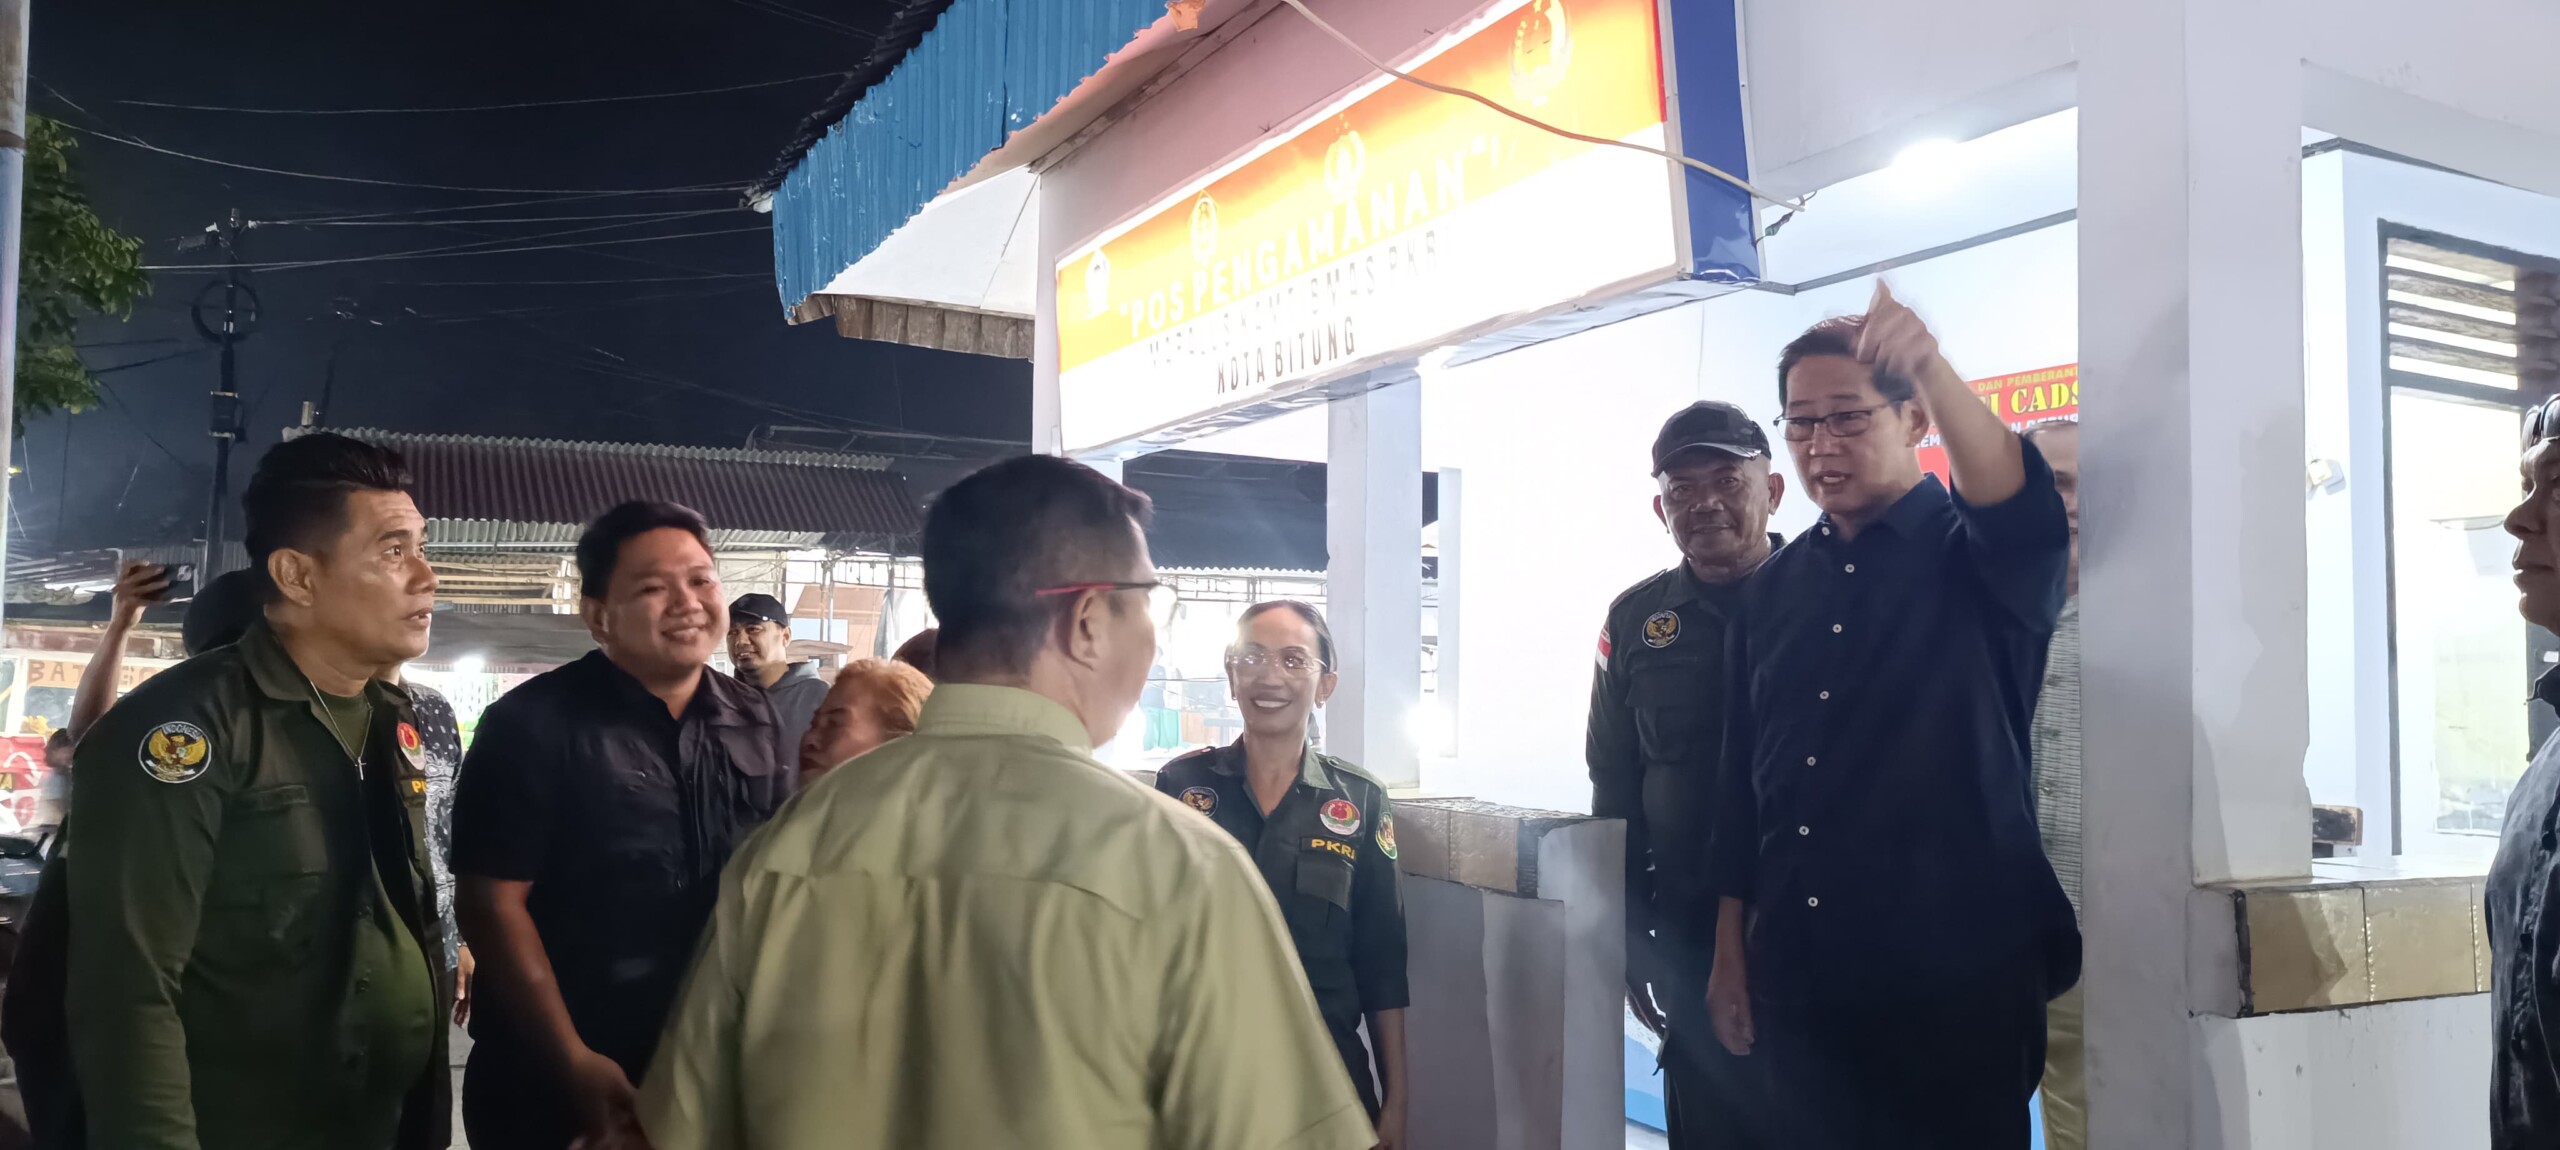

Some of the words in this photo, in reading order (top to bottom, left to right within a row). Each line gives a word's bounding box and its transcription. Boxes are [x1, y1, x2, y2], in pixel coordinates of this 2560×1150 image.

[1217, 346, 1265, 395] KOTA
[1275, 315, 1355, 378] BITUNG
[1311, 838, 1357, 860] PKRI
